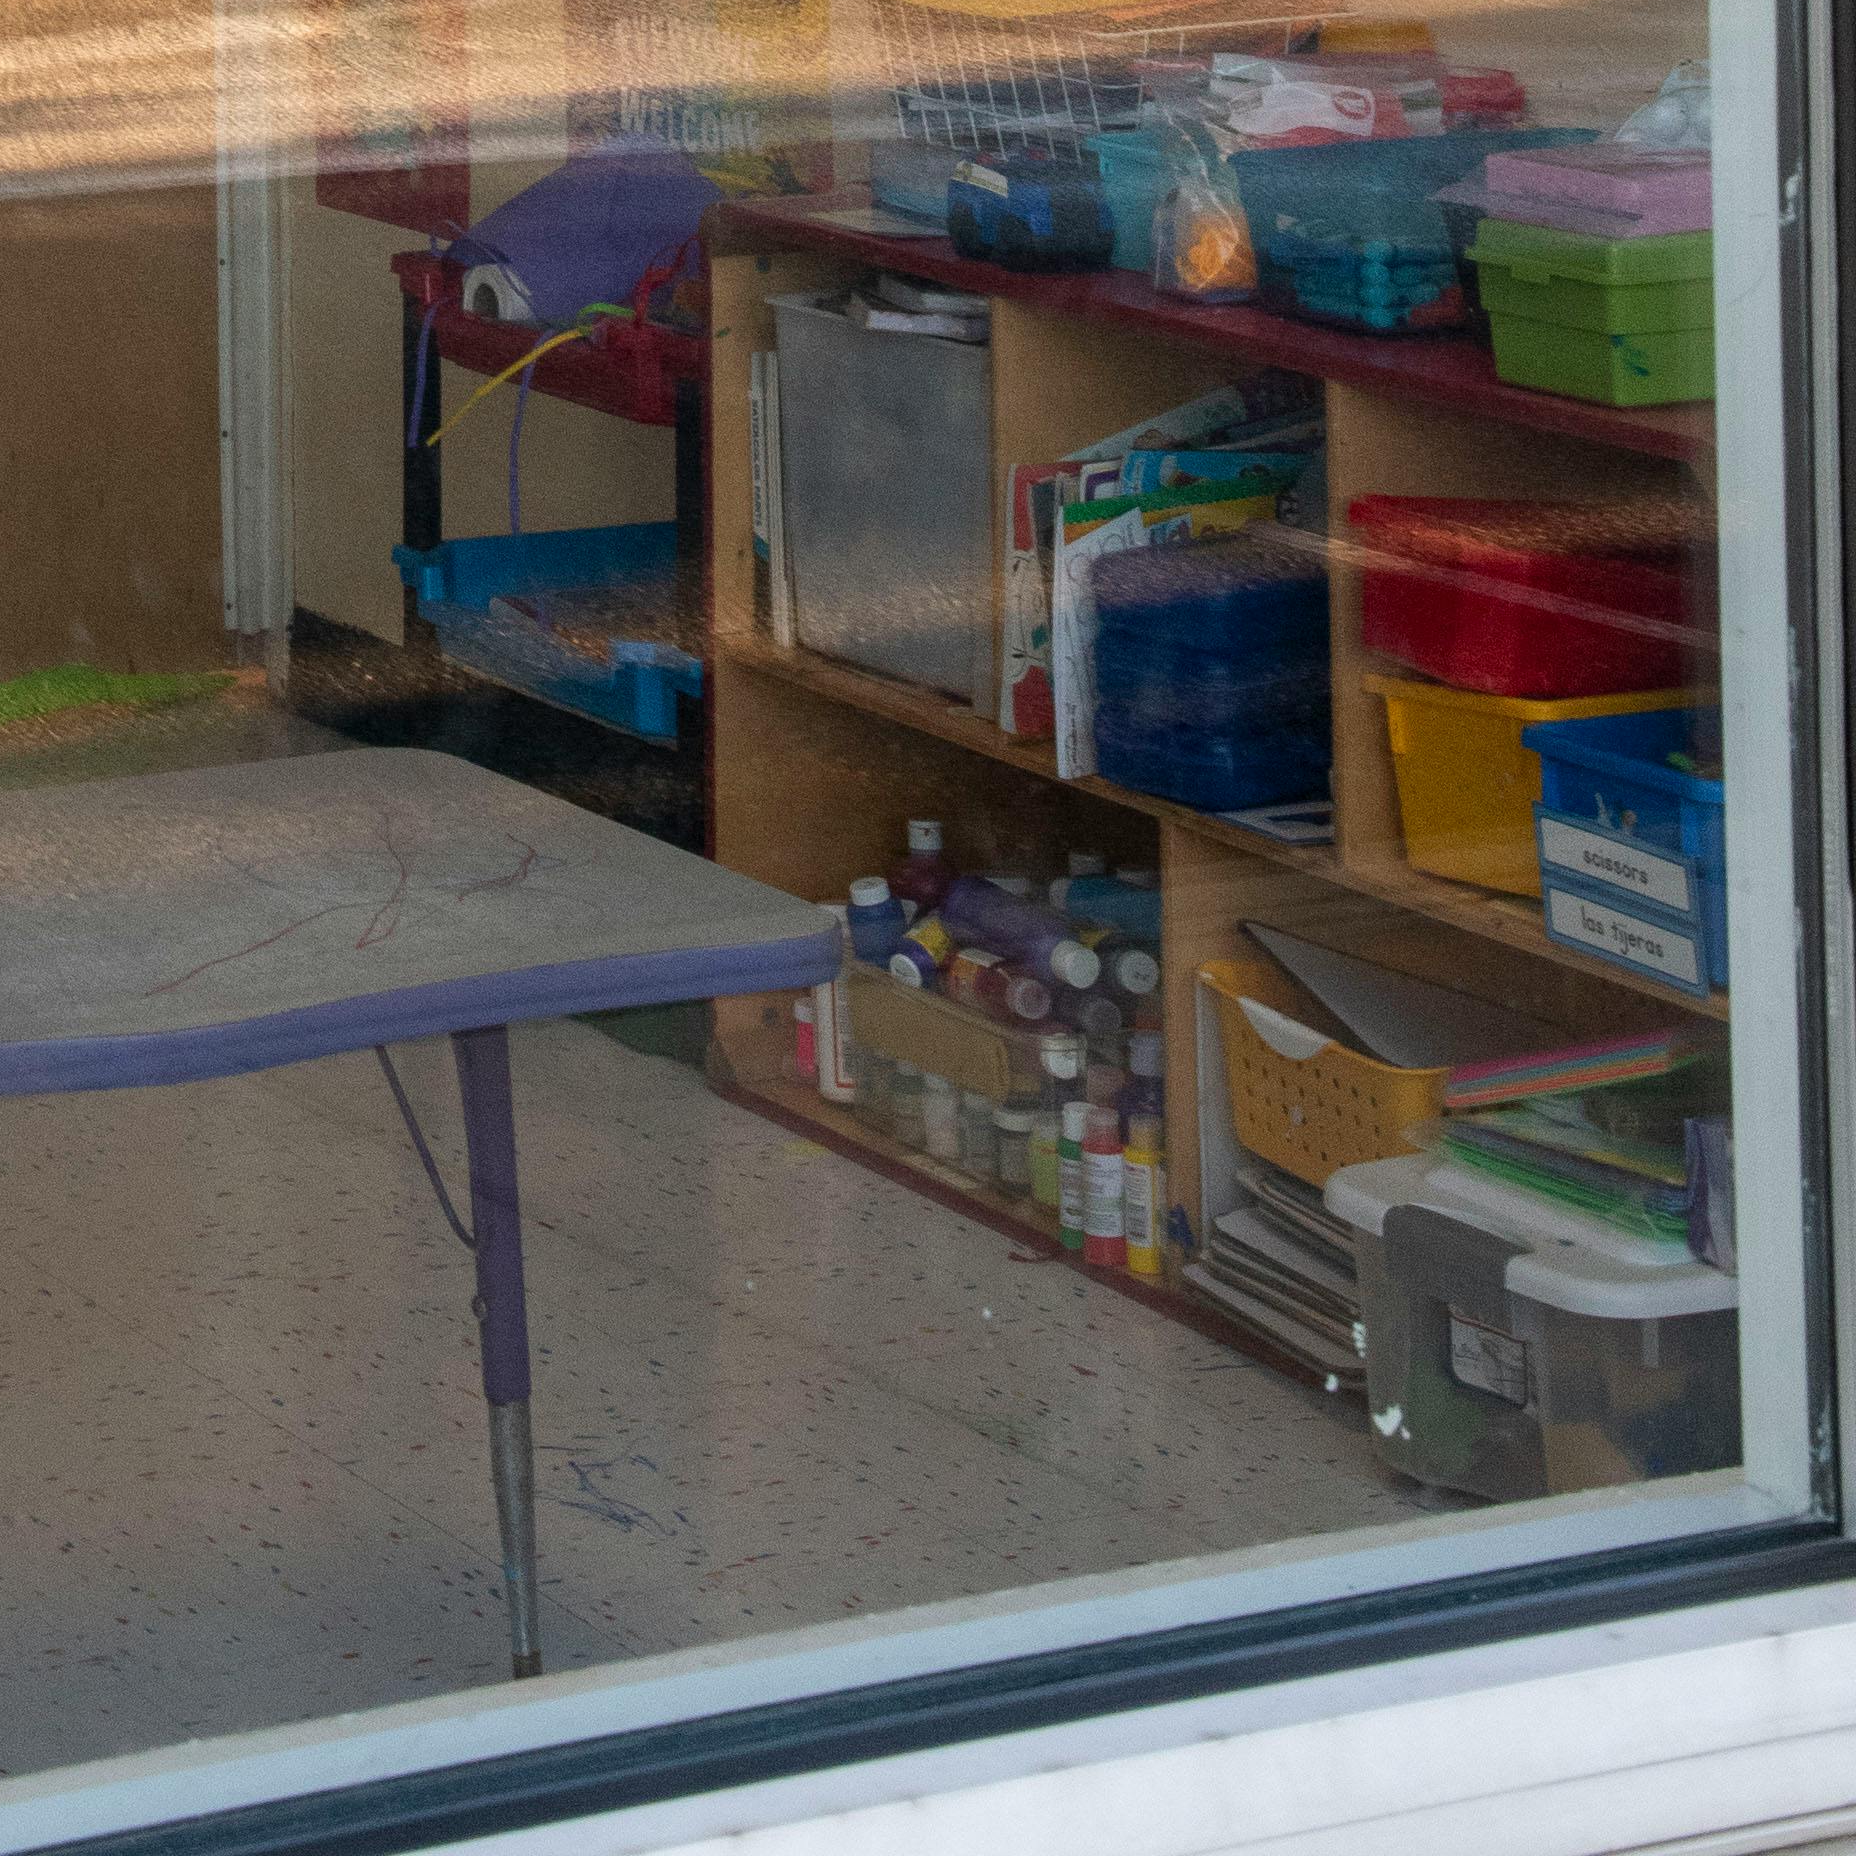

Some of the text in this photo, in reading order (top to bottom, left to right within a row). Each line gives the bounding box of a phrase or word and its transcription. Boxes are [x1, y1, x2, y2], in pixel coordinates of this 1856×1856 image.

[619, 86, 762, 156] WELCOME
[1582, 850, 1648, 885] scissors
[1580, 905, 1604, 935] las
